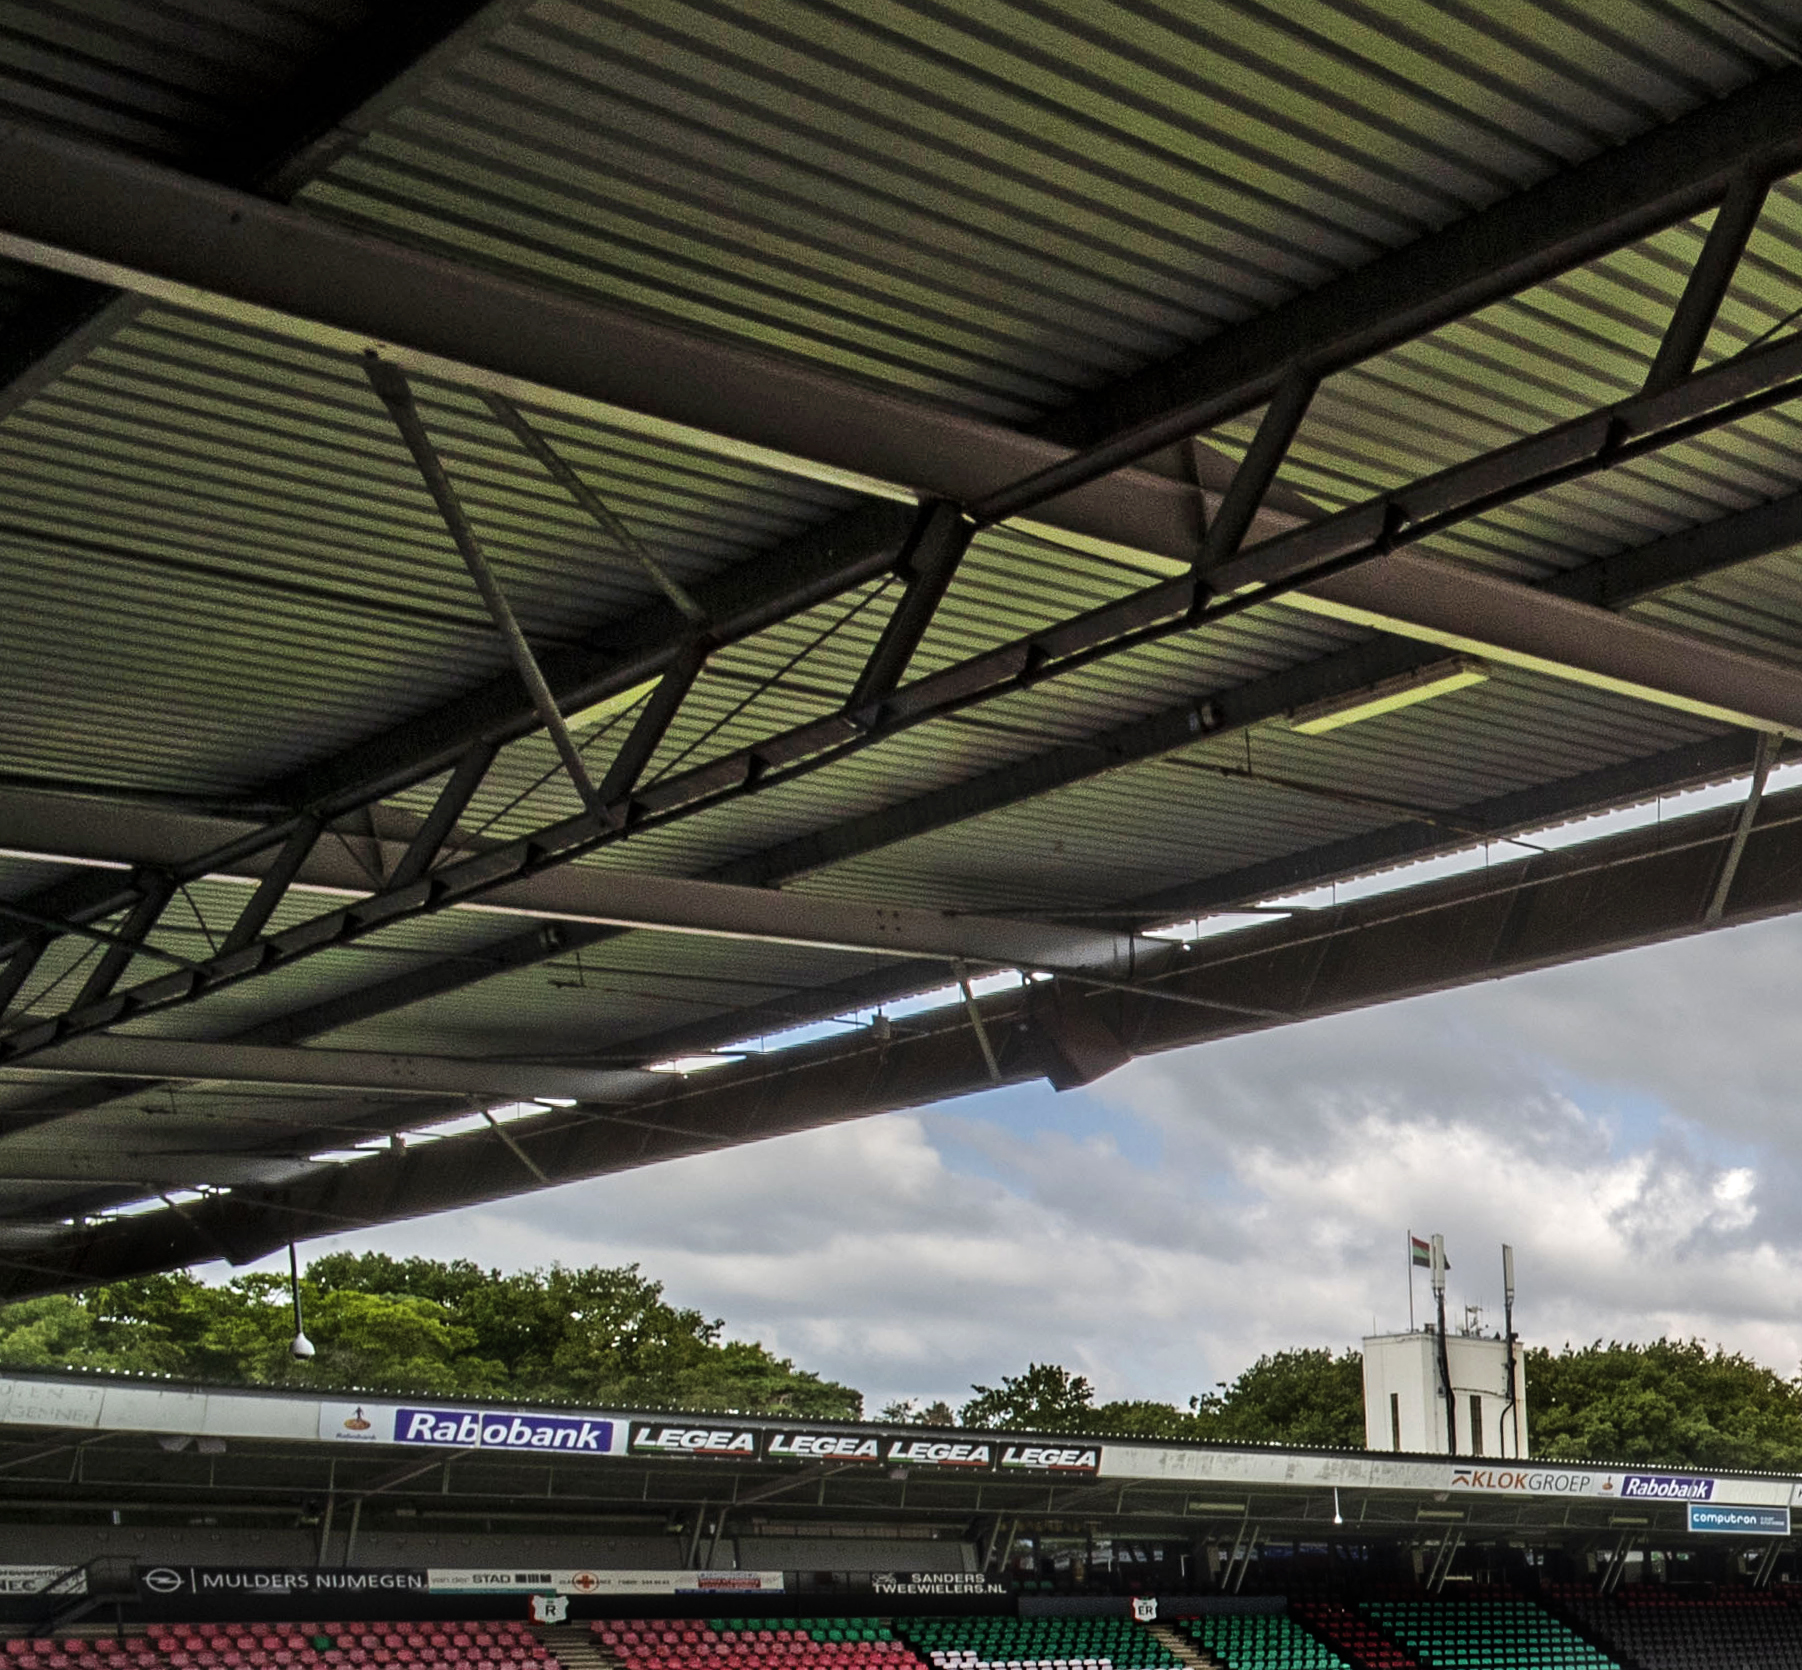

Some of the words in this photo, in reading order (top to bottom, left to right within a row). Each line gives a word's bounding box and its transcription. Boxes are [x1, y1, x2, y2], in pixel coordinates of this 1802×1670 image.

[406, 1413, 601, 1450] Rabobank
[632, 1427, 754, 1452] LEGEA
[769, 1434, 879, 1457] LEGEA
[888, 1440, 990, 1462] LEGEA
[1002, 1446, 1097, 1467] LEGEA
[1471, 1470, 1591, 1493] KLOKGROEP
[1625, 1477, 1709, 1499] Rabobank
[1693, 1512, 1758, 1526] computron
[203, 1573, 309, 1589] MULDERS
[472, 1574, 511, 1584] STAD
[873, 1583, 1008, 1595] TWEEWIELERS.NL
[911, 1573, 986, 1585] SANDERS
